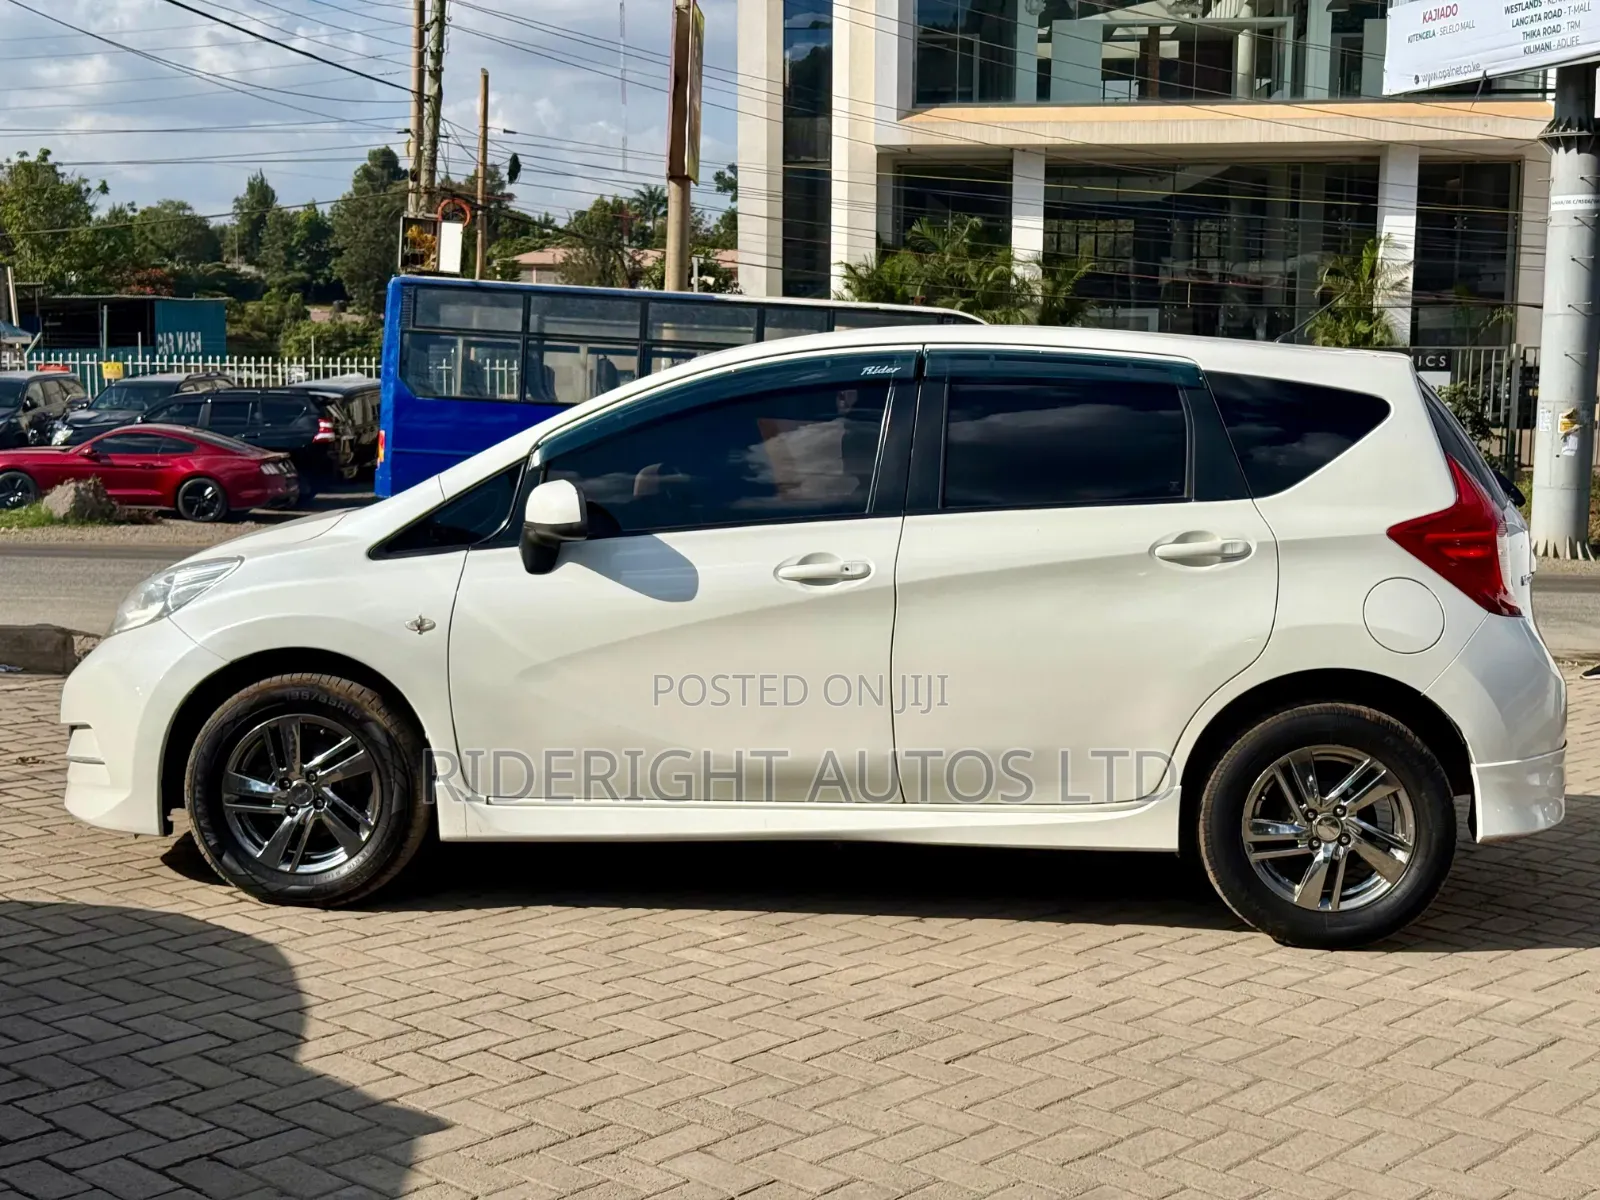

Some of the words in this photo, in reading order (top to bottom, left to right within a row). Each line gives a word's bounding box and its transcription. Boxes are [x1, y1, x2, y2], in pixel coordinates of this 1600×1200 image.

[1422, 3, 1458, 24] KAJIADO
[1504, 0, 1542, 15] WESTLANDS
[1511, 13, 1542, 28] LANG'ATA
[1543, 9, 1562, 21] ROAD
[1568, 2, 1591, 15] T-MALL
[1460, 20, 1475, 31] MALL
[1522, 29, 1541, 41] THIKA
[1542, 24, 1561, 36] ROAD
[1567, 20, 1580, 31] TRM
[1523, 41, 1552, 55] KILIMANI
[157, 332, 175, 355] CAR
[860, 365, 901, 376] Rider
